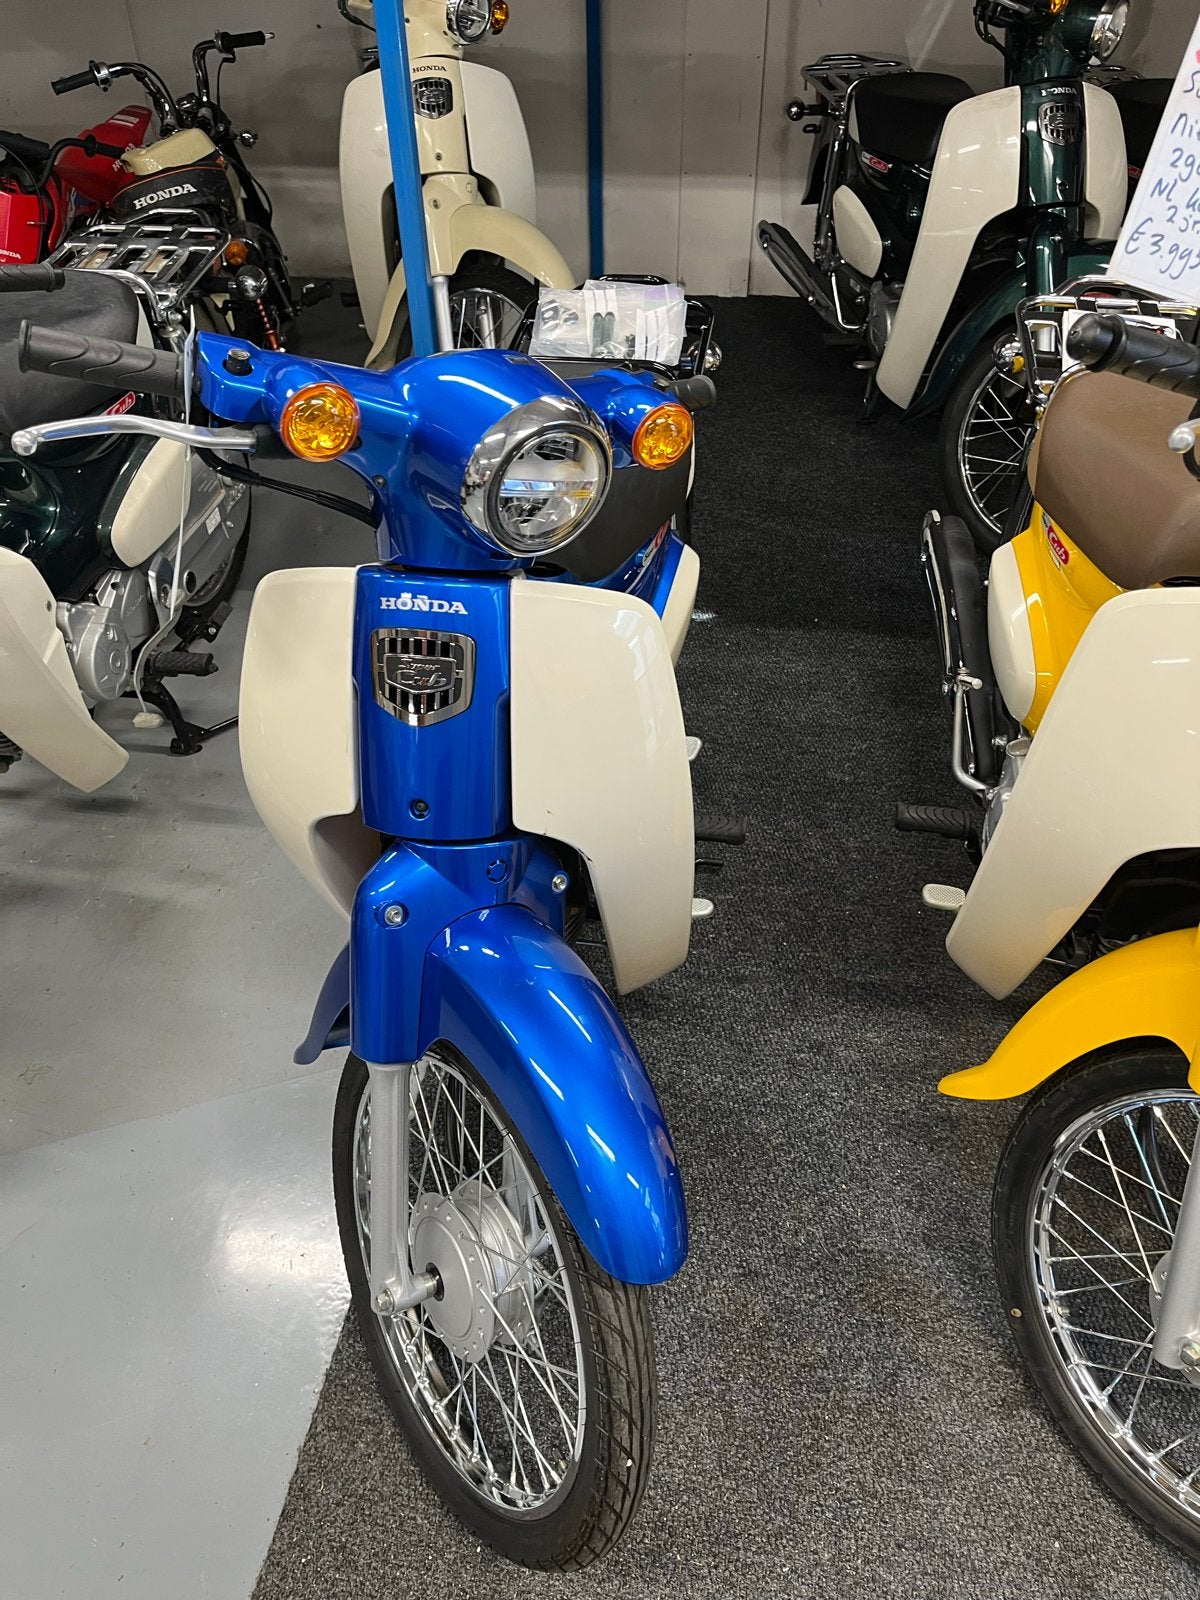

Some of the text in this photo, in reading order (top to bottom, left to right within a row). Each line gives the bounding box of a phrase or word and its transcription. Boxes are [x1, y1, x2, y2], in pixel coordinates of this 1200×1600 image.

[412, 65, 447, 73] HONDA
[133, 183, 197, 209] HONDA
[1049, 532, 1065, 560] Cub
[380, 596, 468, 615] HONDA
[393, 669, 447, 688] Cub
